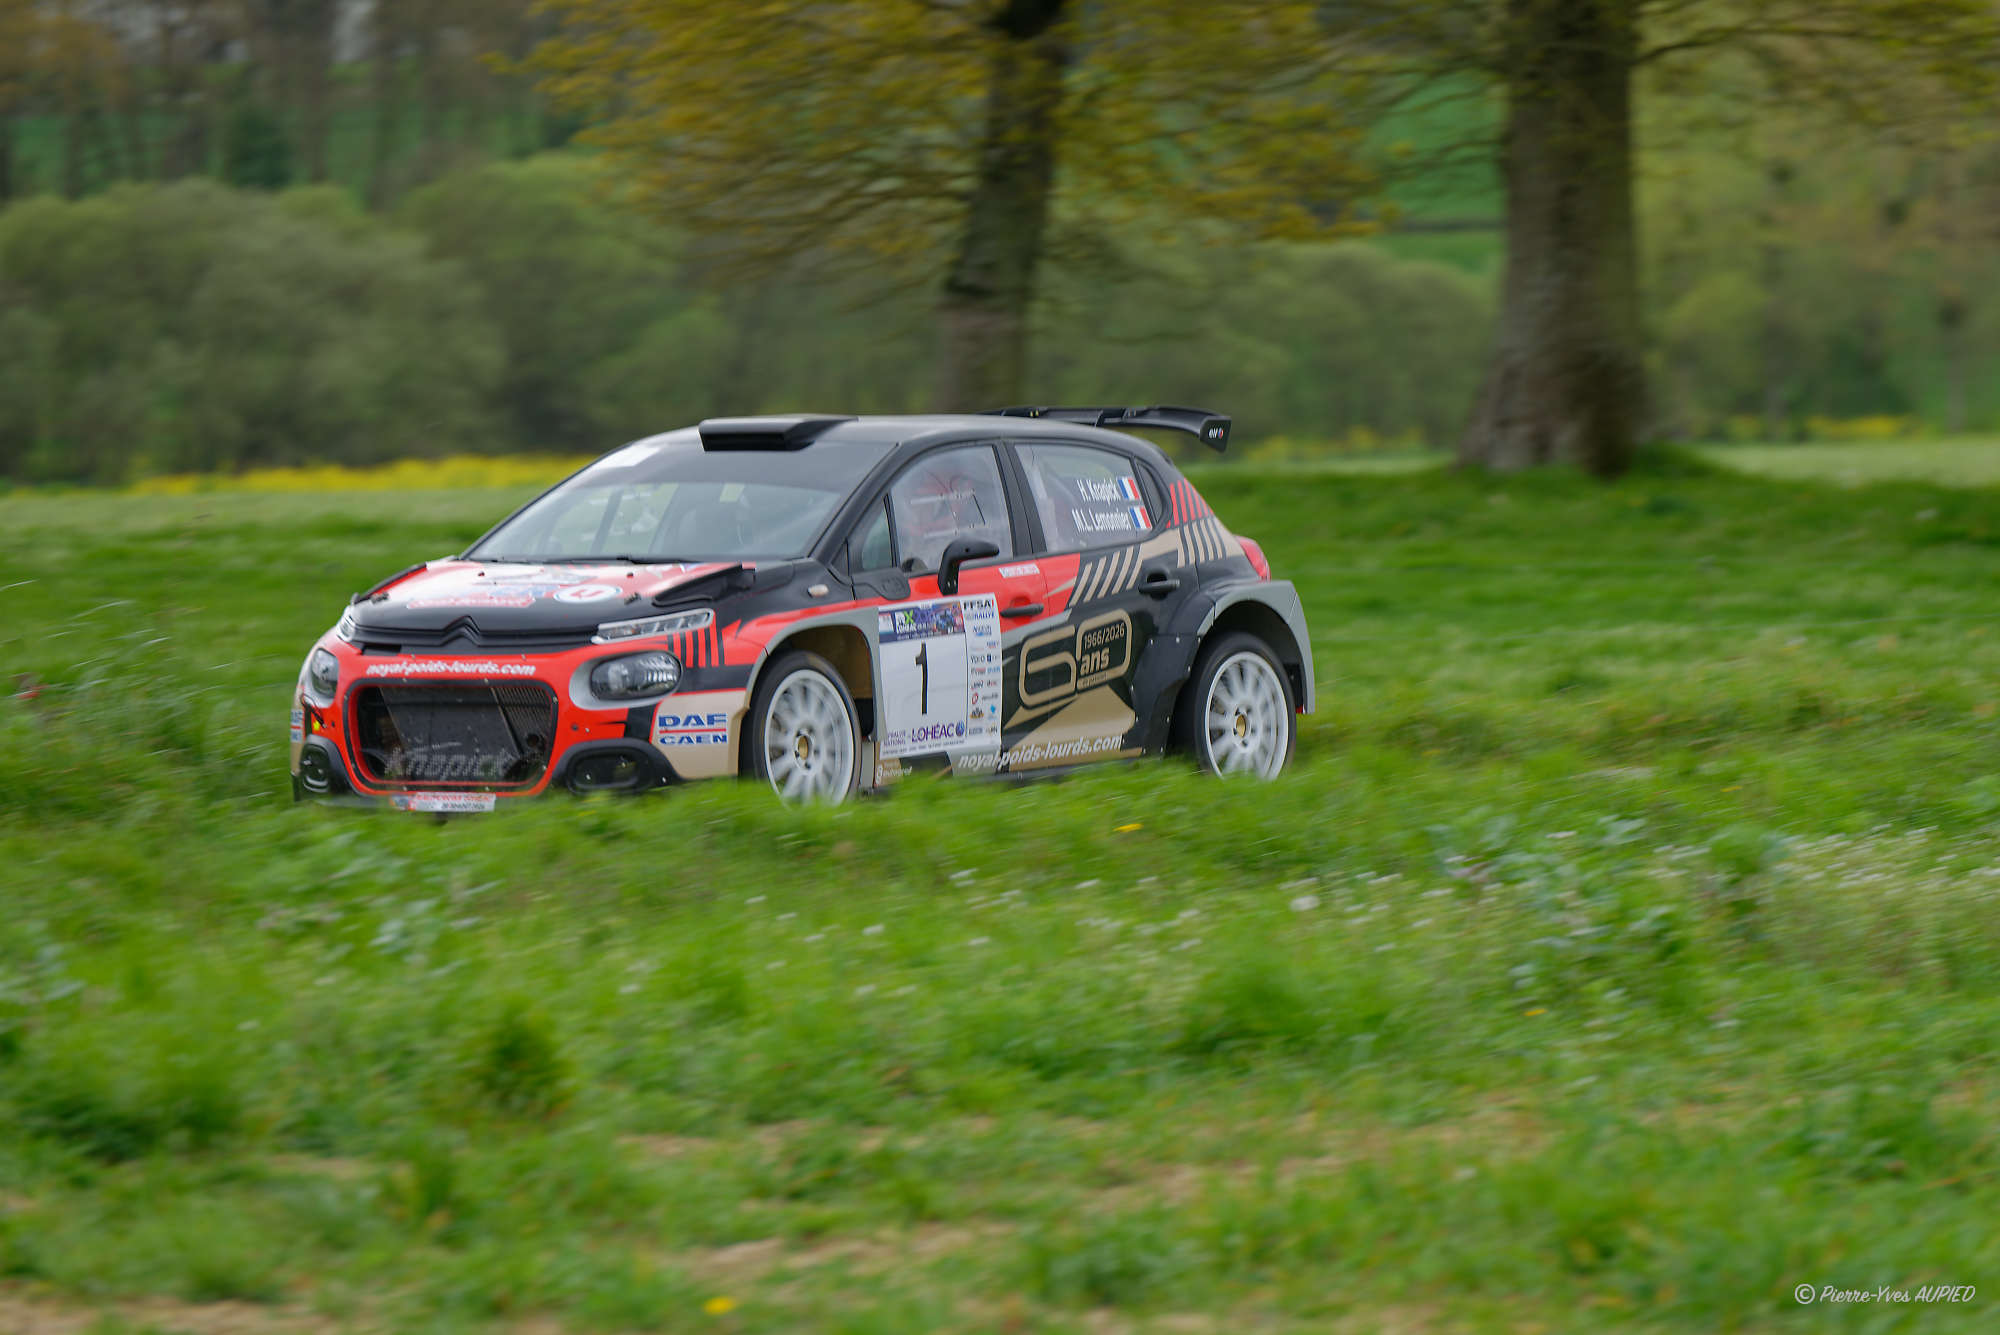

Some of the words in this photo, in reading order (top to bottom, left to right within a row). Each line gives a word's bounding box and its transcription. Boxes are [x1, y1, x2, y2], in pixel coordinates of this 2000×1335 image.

[1087, 507, 1132, 531] Lemonnier
[963, 599, 992, 610] FFSA
[1083, 622, 1125, 652] 1966/2026
[366, 660, 536, 677] noyal-poids-lourds.com
[1080, 647, 1110, 676] ans
[915, 641, 928, 716] 1
[658, 713, 727, 727] DAF
[911, 720, 955, 743] LOHÉAC
[659, 735, 728, 745] CAEN
[957, 733, 1122, 771] noyal-poids-lourds.com
